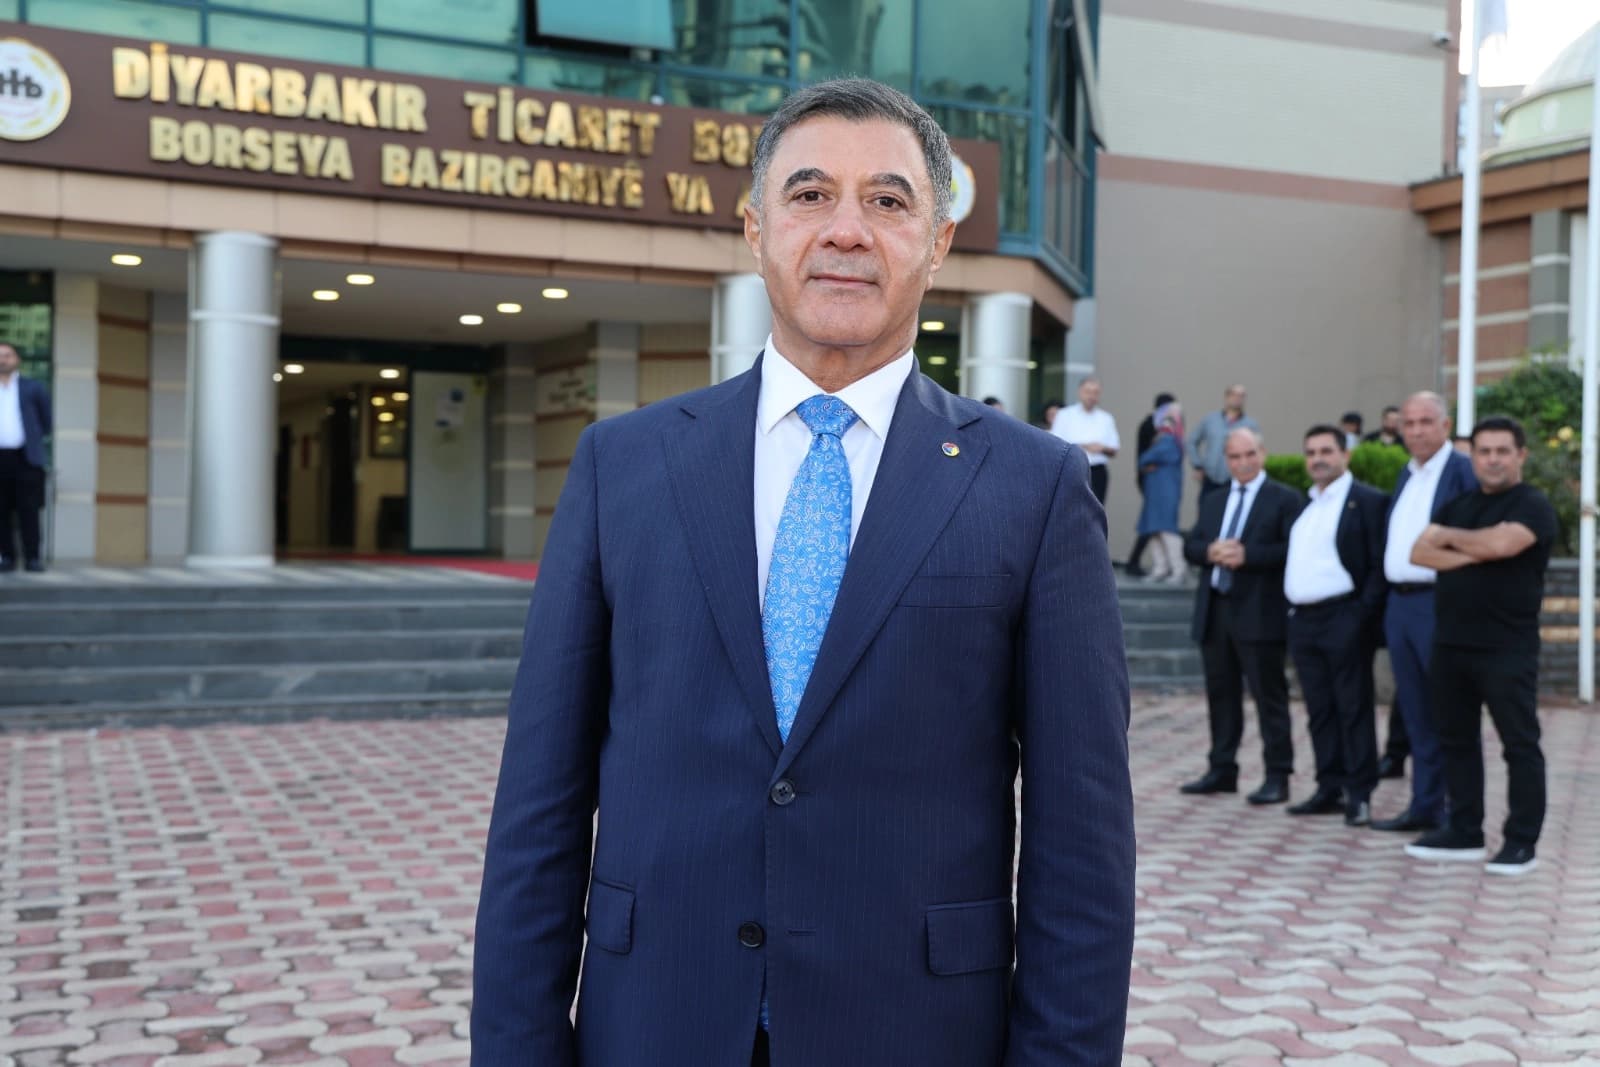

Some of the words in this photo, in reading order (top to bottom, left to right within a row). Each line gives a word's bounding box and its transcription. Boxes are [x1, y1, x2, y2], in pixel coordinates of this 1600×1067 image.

[112, 42, 427, 132] DİYARBAKIR
[464, 87, 661, 155] TİCARET
[150, 116, 354, 181] BORSEYA
